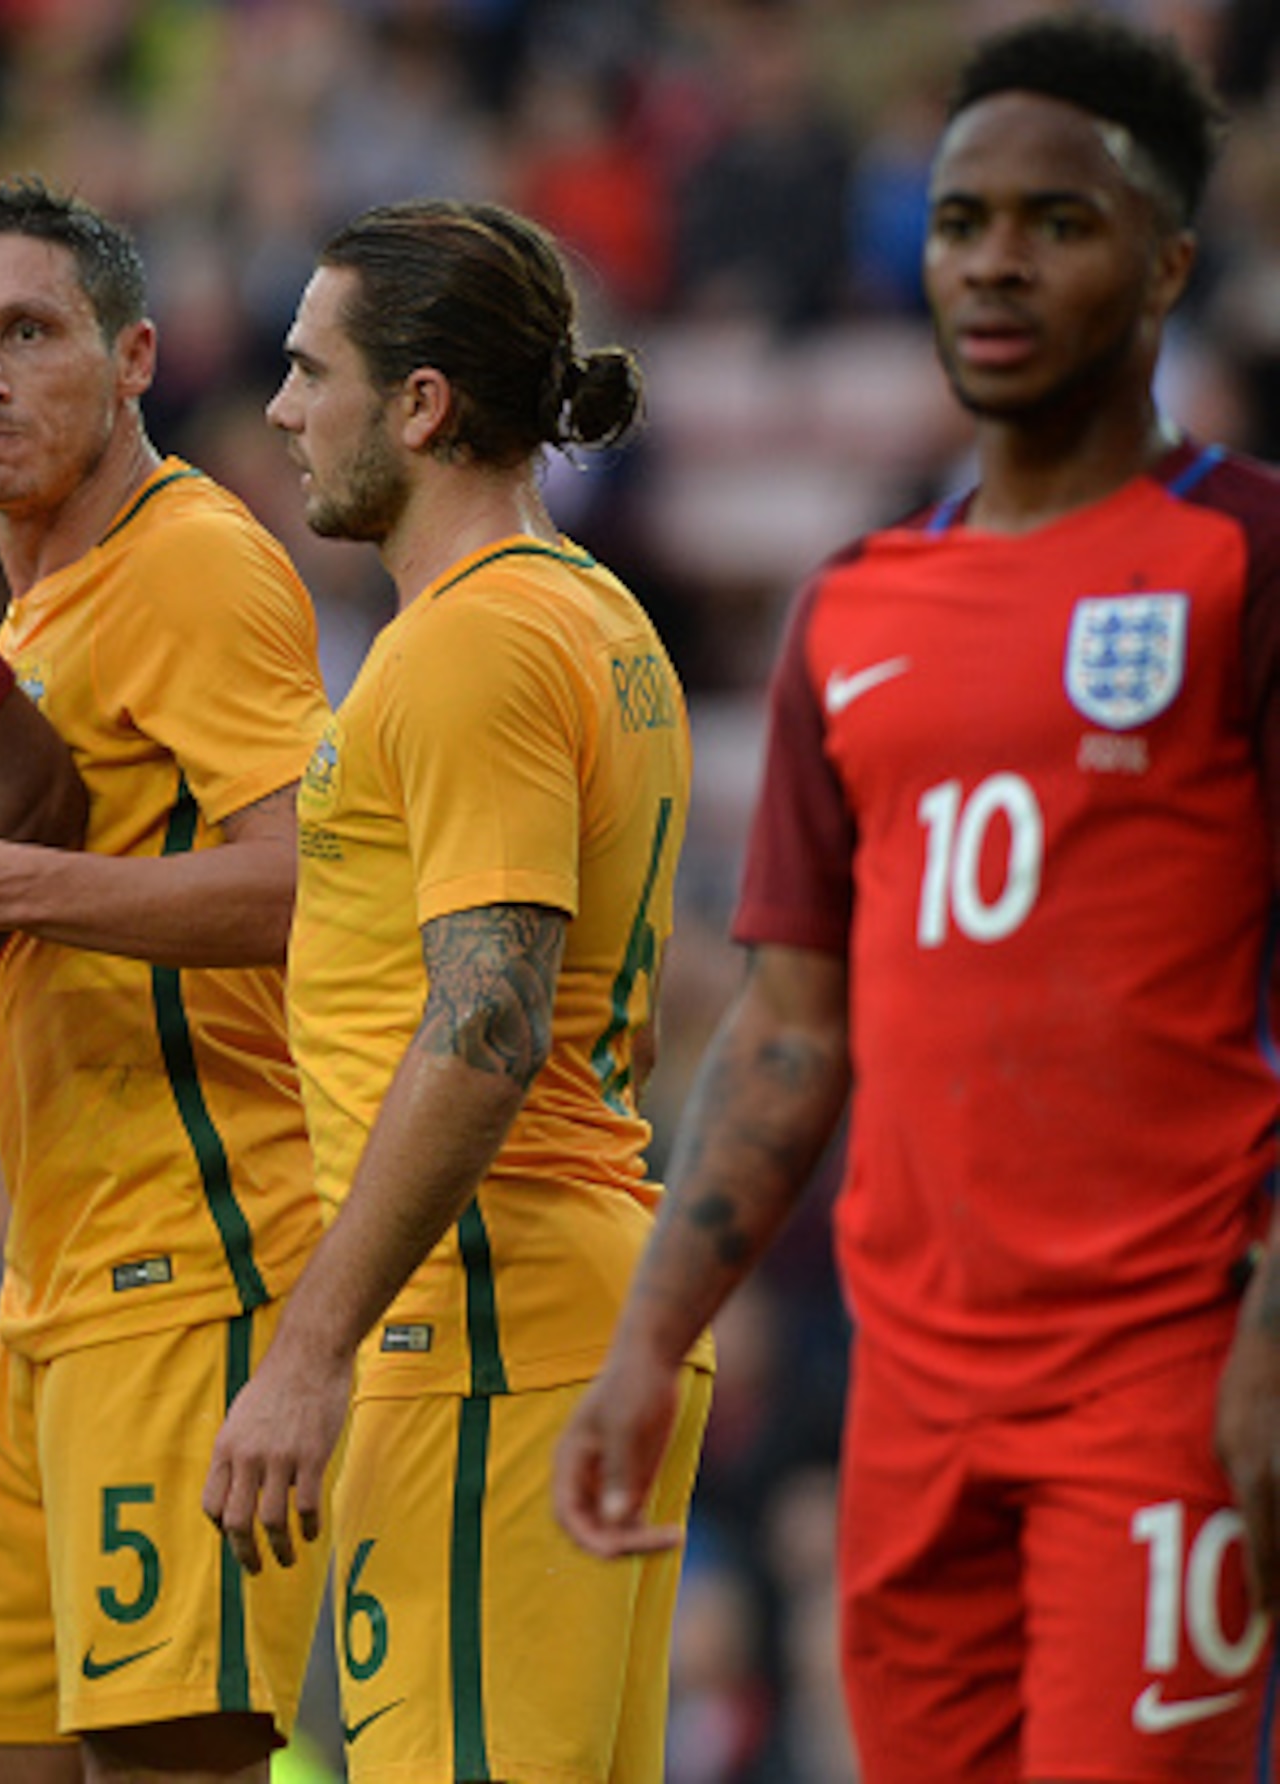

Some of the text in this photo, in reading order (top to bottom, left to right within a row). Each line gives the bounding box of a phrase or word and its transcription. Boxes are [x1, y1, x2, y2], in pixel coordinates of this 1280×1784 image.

[917, 772, 1045, 949] 10
[98, 1482, 161, 1624] 5
[344, 1539, 388, 1681] 6
[1131, 1499, 1270, 1678] 10
